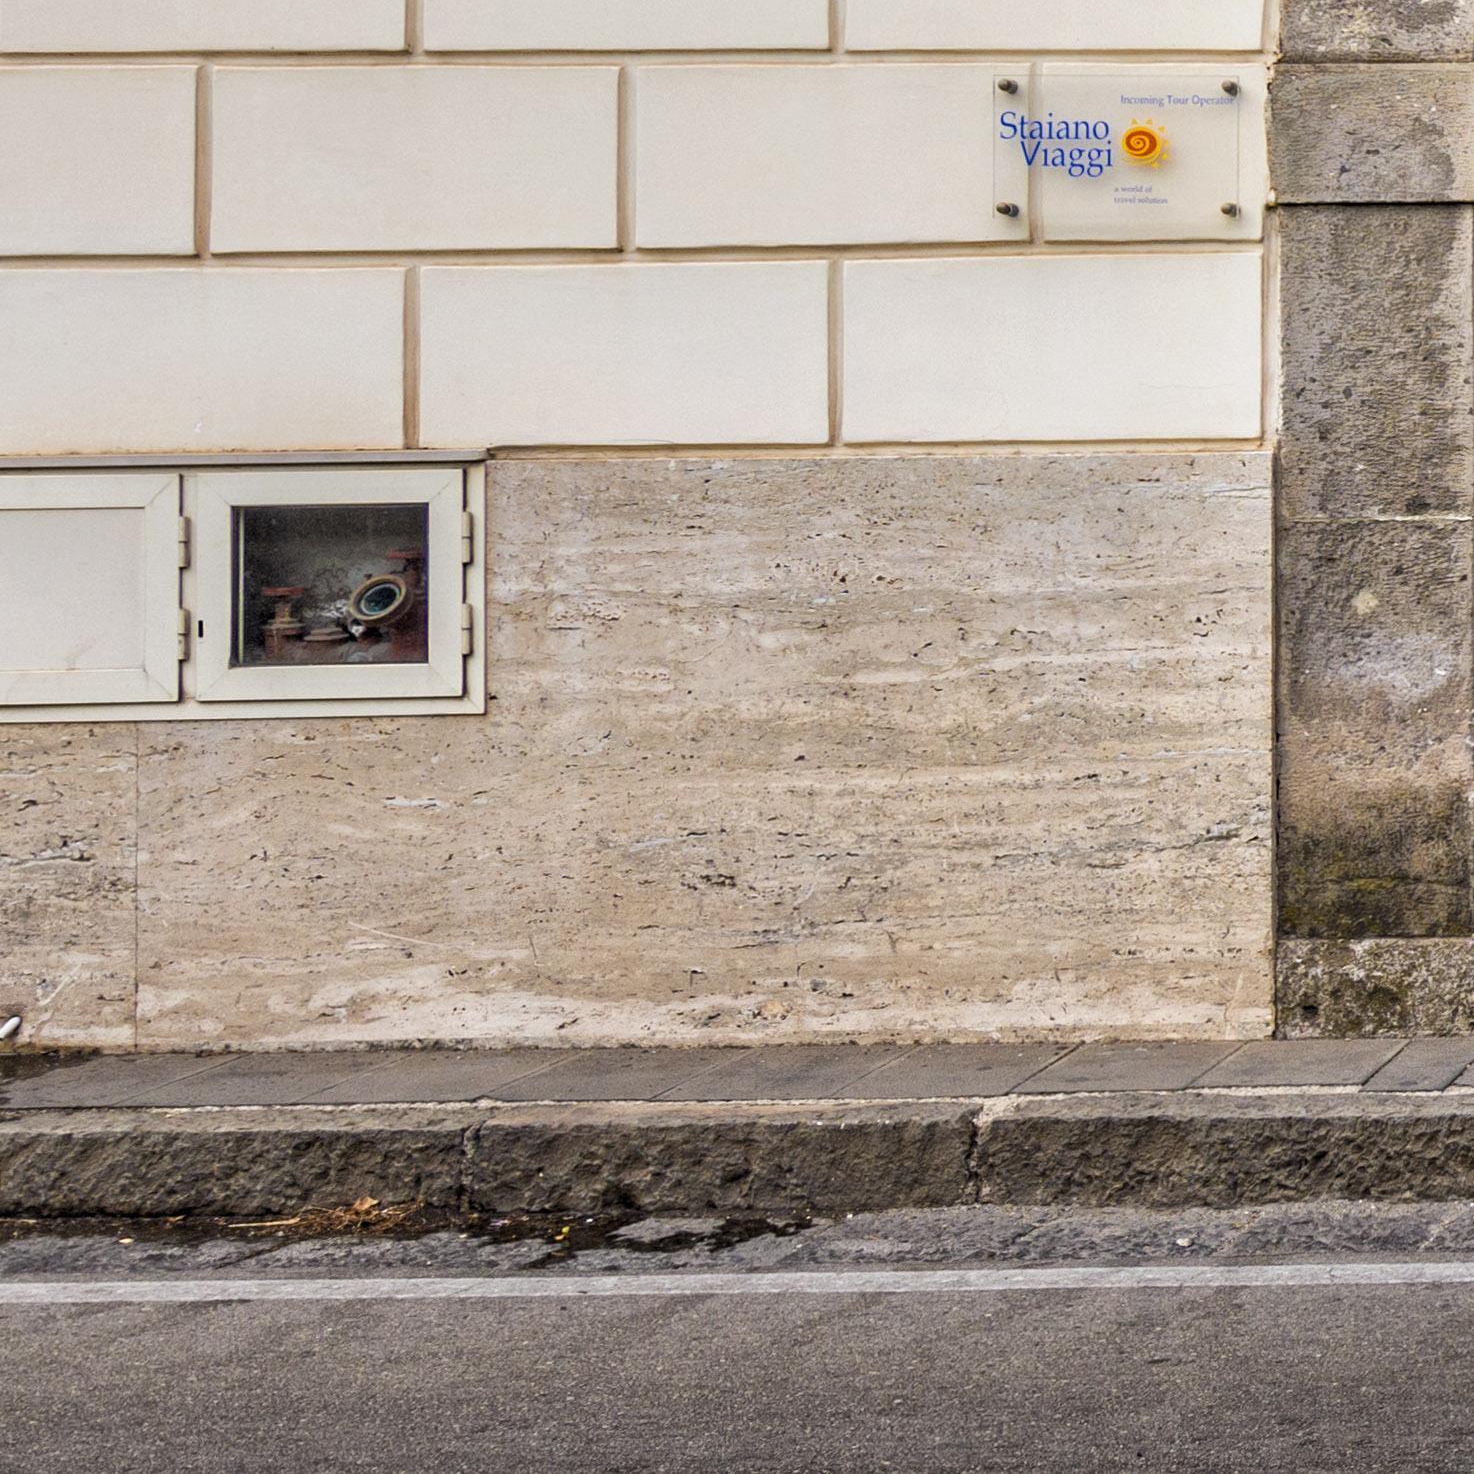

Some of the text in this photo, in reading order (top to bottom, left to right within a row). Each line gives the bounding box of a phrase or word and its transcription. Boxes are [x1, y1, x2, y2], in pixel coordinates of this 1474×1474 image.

[1120, 94, 1234, 108] Incoming Tour Operator
[1000, 112, 1110, 140] Staiano
[1020, 140, 1113, 178] Viaggi
